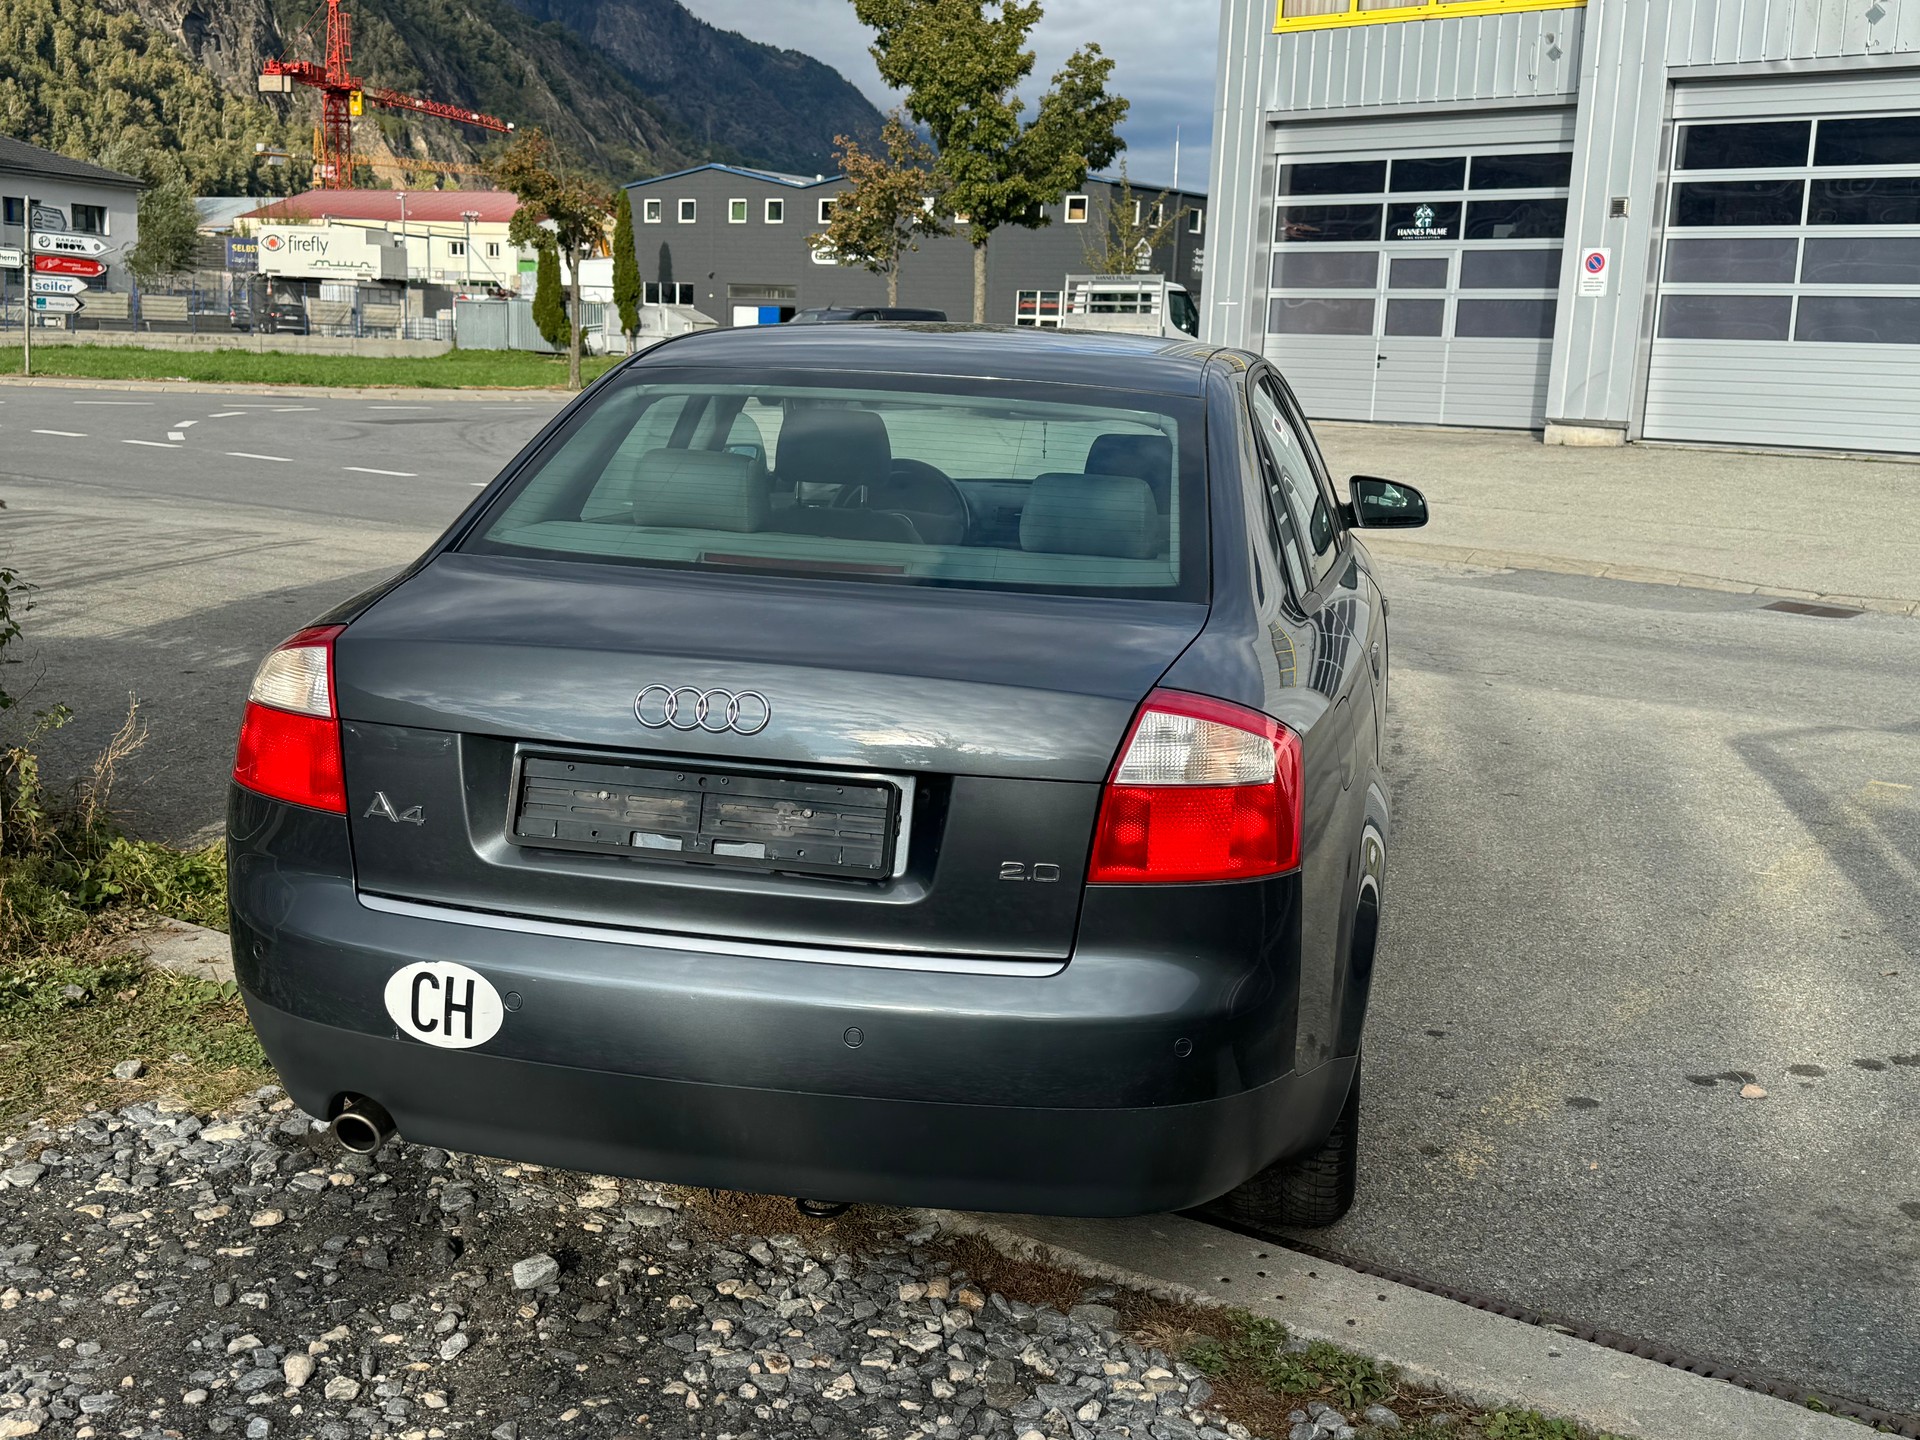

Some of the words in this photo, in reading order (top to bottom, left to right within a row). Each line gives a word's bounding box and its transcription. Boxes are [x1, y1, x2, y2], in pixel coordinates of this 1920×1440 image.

[289, 235, 329, 256] firefly
[35, 281, 72, 291] seiler
[363, 791, 427, 826] A4
[999, 861, 1060, 882] 2.0
[411, 971, 475, 1039] CH
